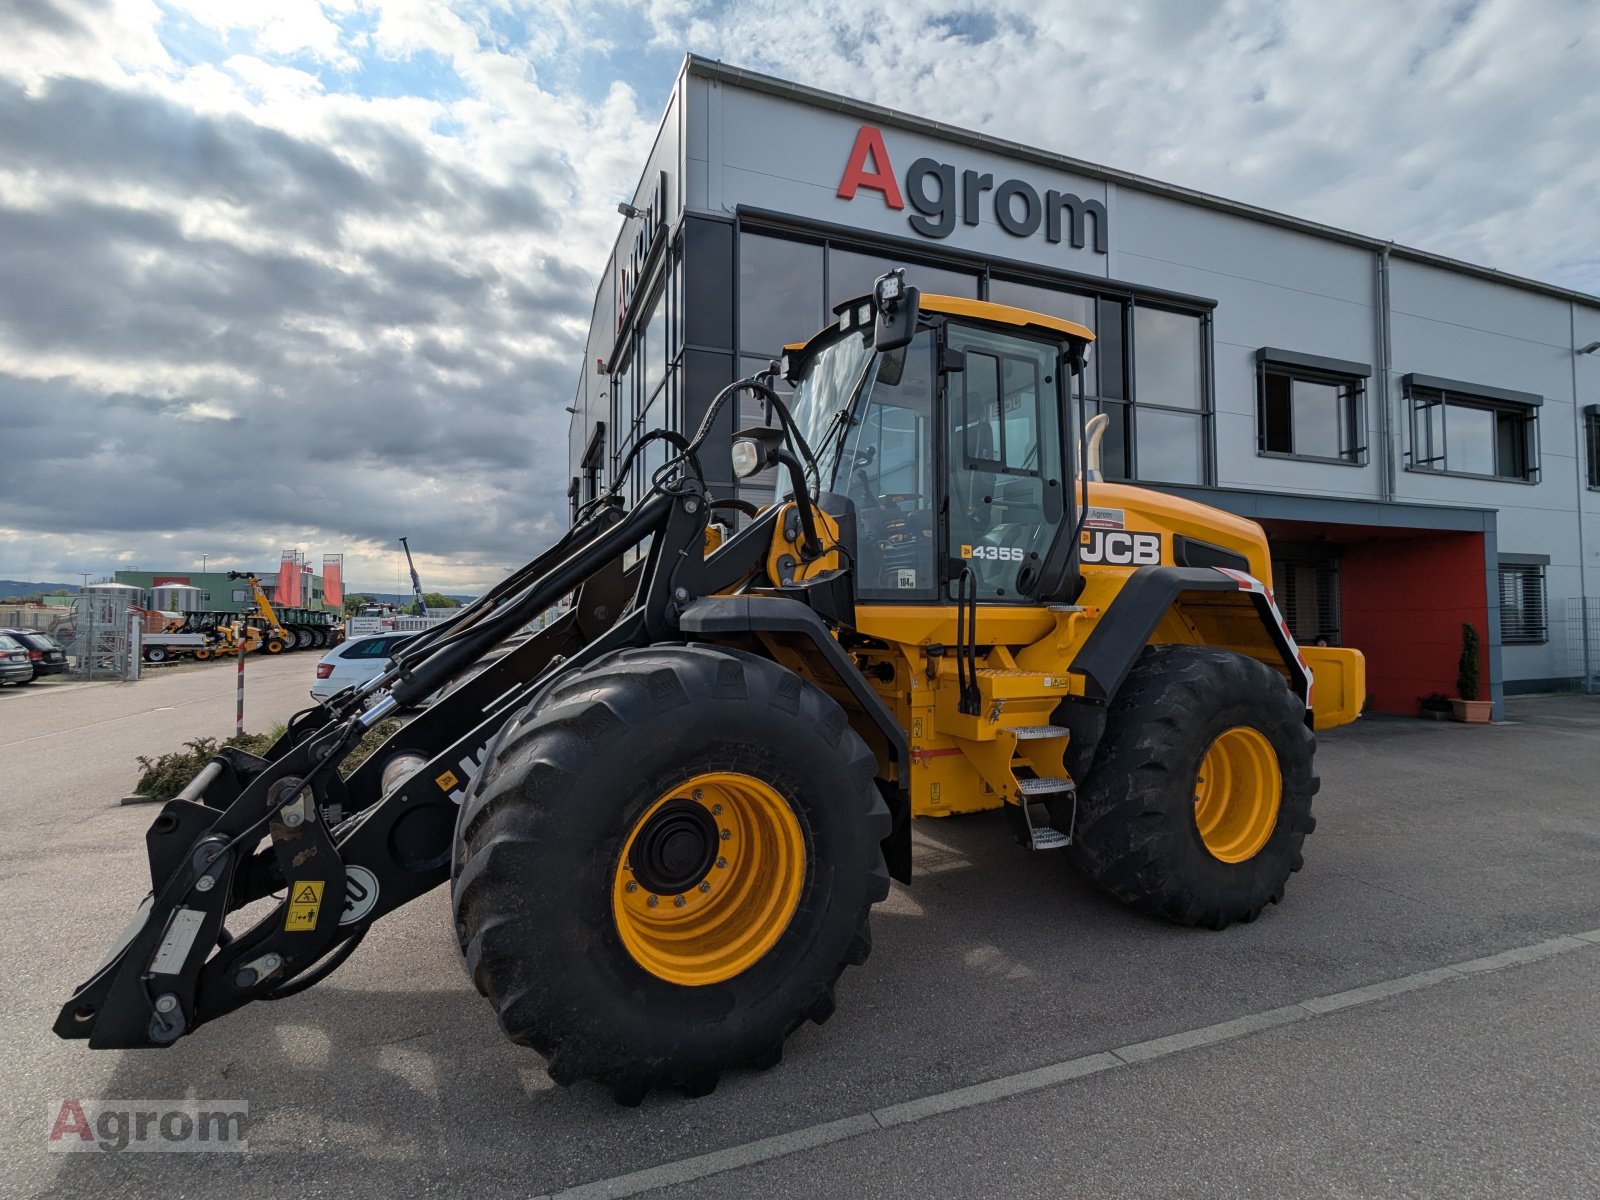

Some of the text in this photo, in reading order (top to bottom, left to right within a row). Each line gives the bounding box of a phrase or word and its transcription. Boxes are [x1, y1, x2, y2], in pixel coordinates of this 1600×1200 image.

[837, 124, 1108, 254] Agrom
[1092, 510, 1112, 519] Agrom
[973, 546, 1024, 561] 435S
[1081, 532, 1159, 565] JCB
[900, 577, 909, 587] 104
